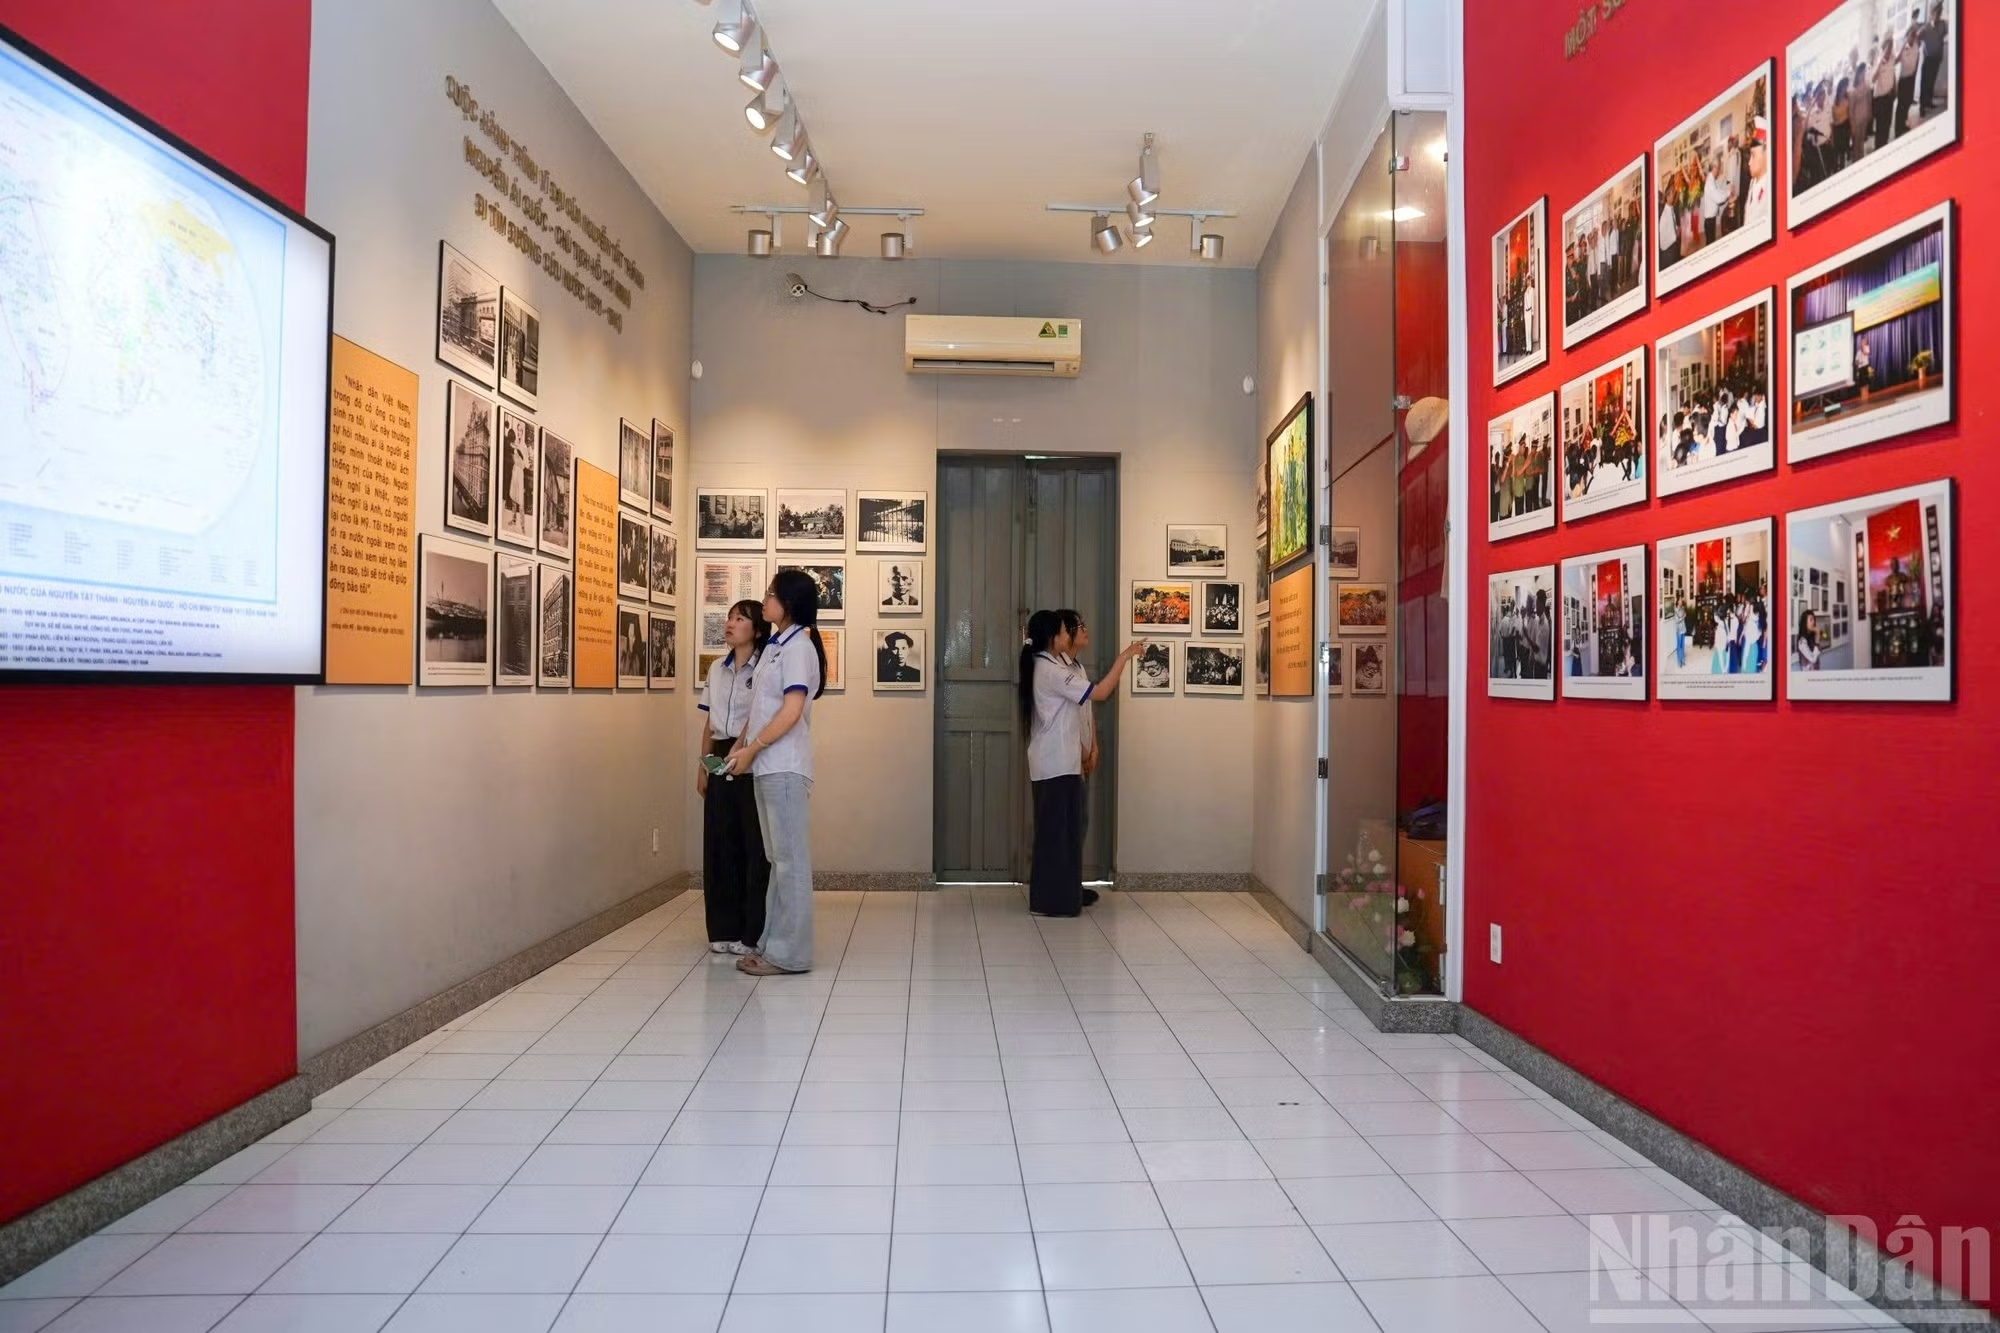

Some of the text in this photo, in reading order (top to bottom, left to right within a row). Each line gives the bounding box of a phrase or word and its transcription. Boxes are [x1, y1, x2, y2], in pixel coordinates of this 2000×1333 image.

[1565, 5, 1597, 59] MỘT
[446, 75, 478, 122] CUỘC
[522, 194, 548, 232] QUỐC
[475, 193, 487, 220] ĐI
[488, 201, 507, 236] TÌM
[507, 221, 542, 265] ĐƯỜNG
[543, 251, 562, 281] CỨU
[561, 268, 585, 302] NƯỚC
